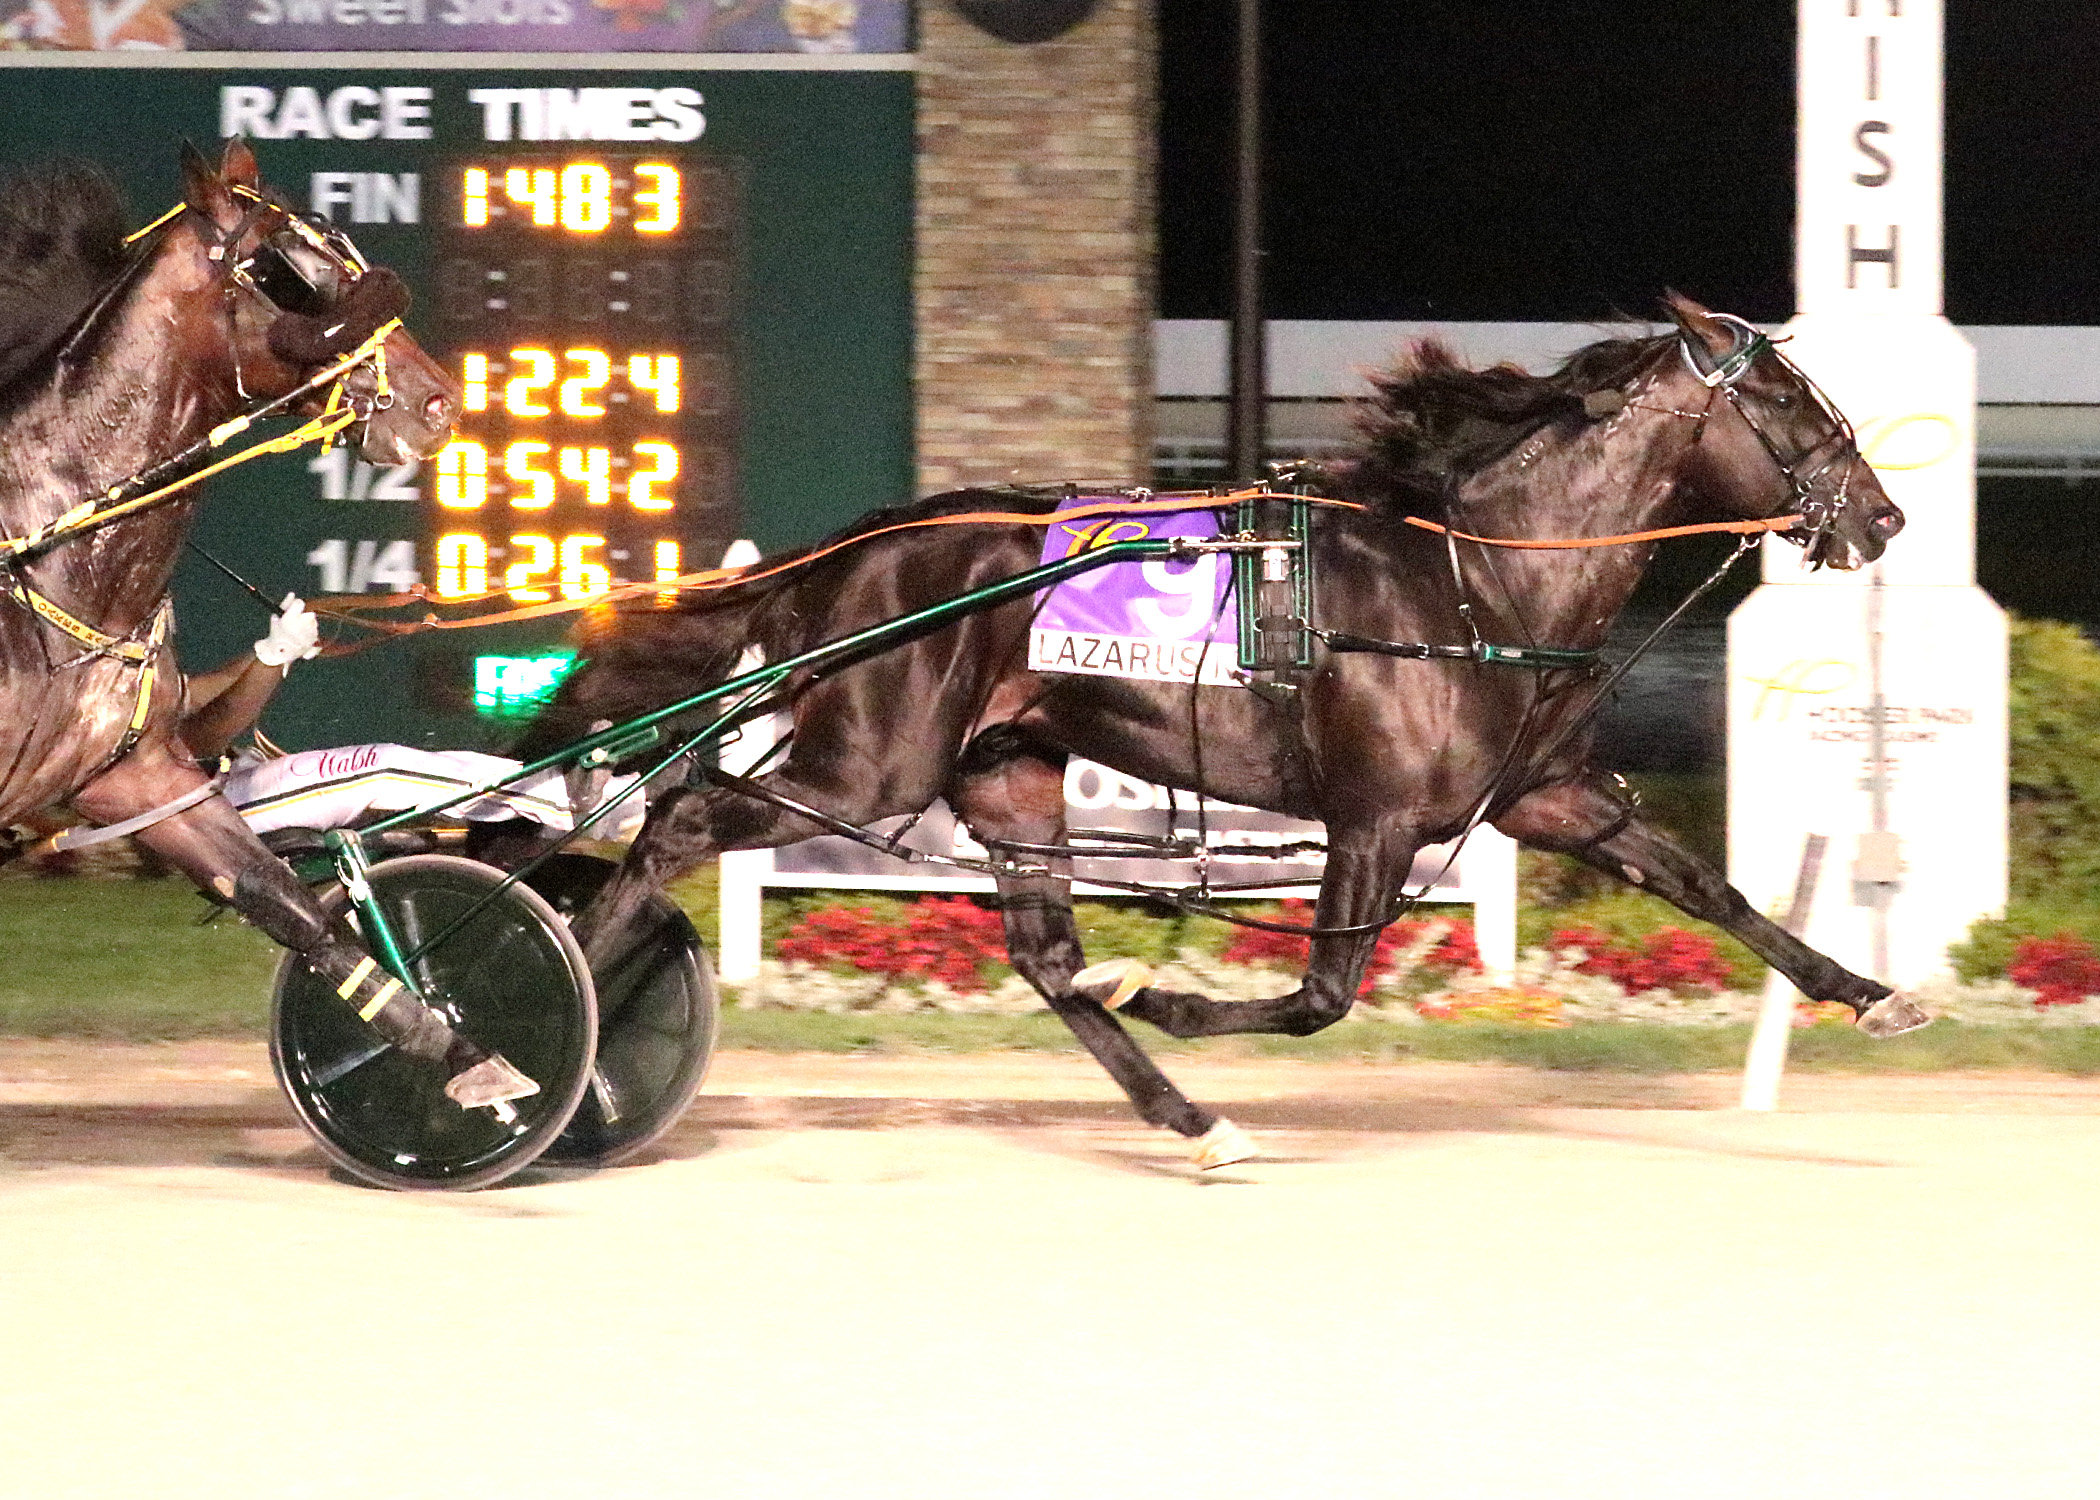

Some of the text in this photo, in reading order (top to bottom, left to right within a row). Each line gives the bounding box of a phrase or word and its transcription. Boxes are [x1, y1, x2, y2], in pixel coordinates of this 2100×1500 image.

[219, 85, 706, 141] RACE TIMES
[311, 172, 419, 224] FIN
[307, 446, 421, 501] 1/2
[306, 539, 421, 593] 1/4
[1136, 551, 1217, 639] 9
[1039, 633, 1198, 678] LAZARUS
[290, 743, 379, 778] Walsh
